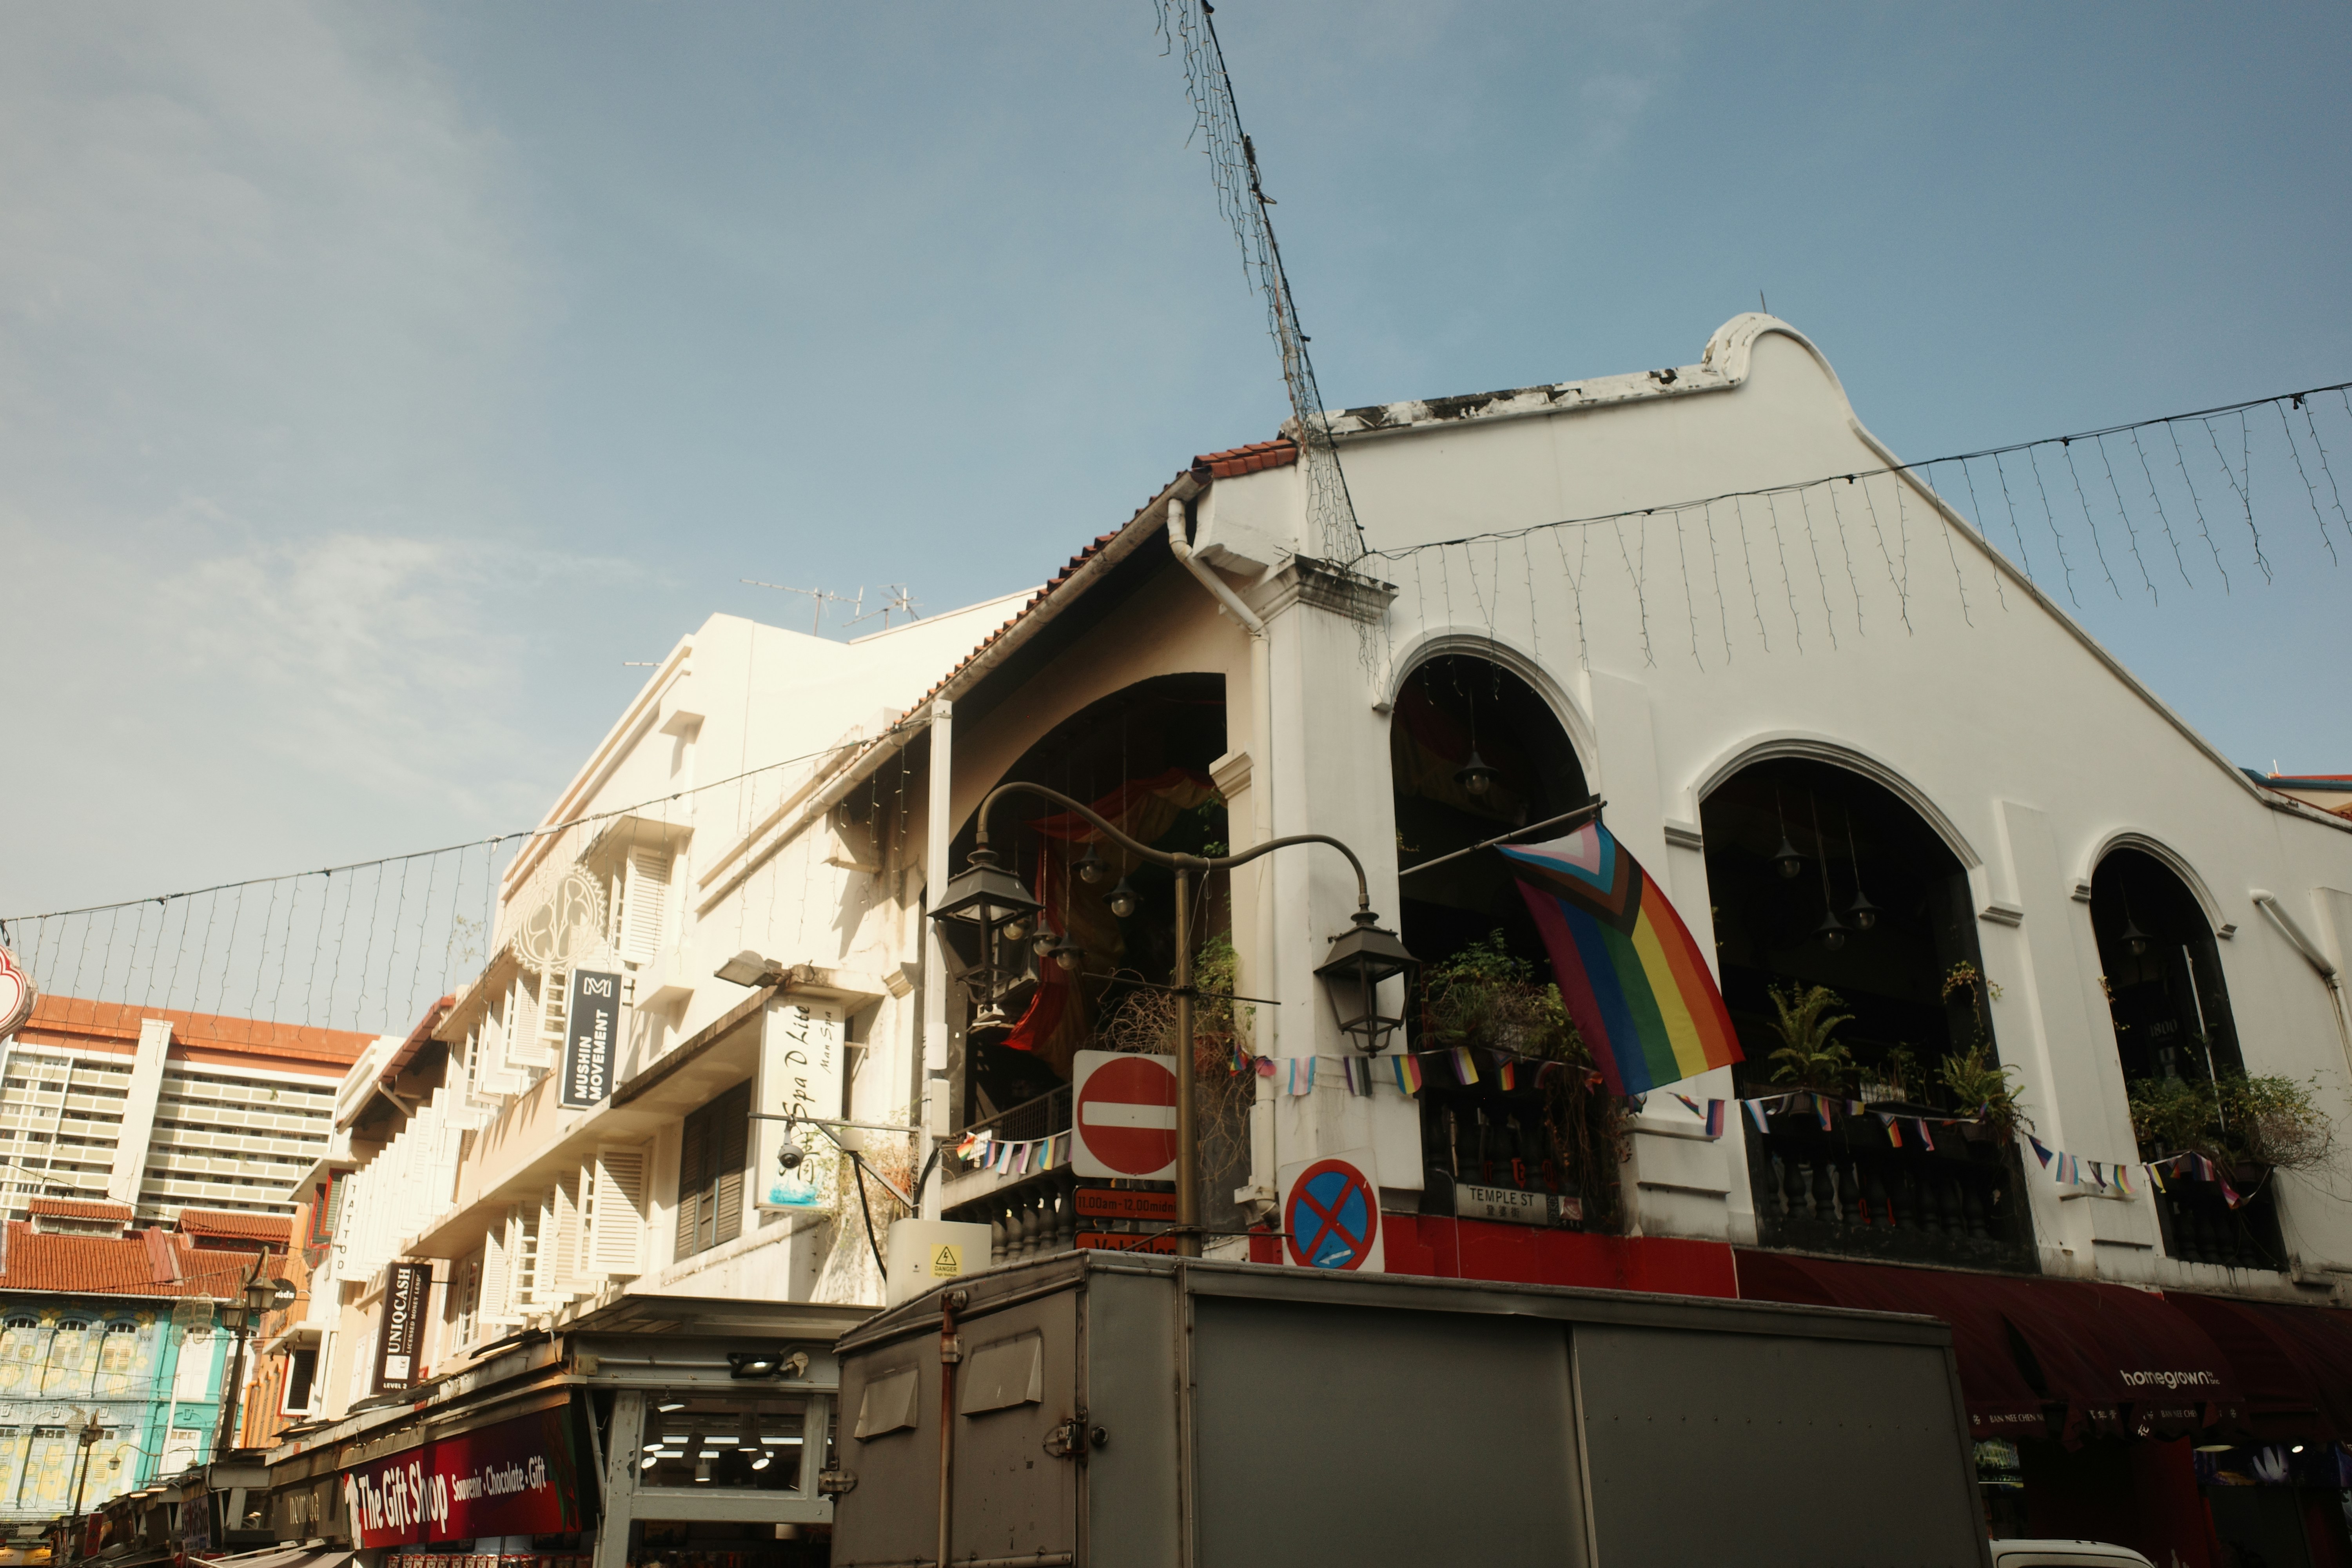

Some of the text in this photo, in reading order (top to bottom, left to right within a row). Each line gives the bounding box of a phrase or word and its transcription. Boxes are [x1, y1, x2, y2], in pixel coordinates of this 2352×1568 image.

[785, 1006, 810, 1045] Lite
[820, 1011, 835, 1074] Man Spa
[2149, 1019, 2178, 1037] 1800
[575, 1036, 592, 1099] MUSHIN
[589, 1009, 608, 1100] MOVEMENT
[785, 1051, 807, 1068] D
[782, 1077, 815, 1126] Spa
[1470, 1187, 1534, 1206] TEMPLE ST
[338, 1185, 357, 1269] TATTOO
[388, 1267, 411, 1353] UNIQCASH
[406, 1321, 416, 1354] LICENSED
[411, 1296, 419, 1319] MONEY
[2120, 1370, 2210, 1389] homegrown
[1989, 1414, 2004, 1423] BAN
[2005, 1414, 2018, 1422] NEE
[2018, 1414, 2036, 1422] CHEN
[359, 1455, 546, 1535] The Gift Shop Souvenir Chocolate Gift
